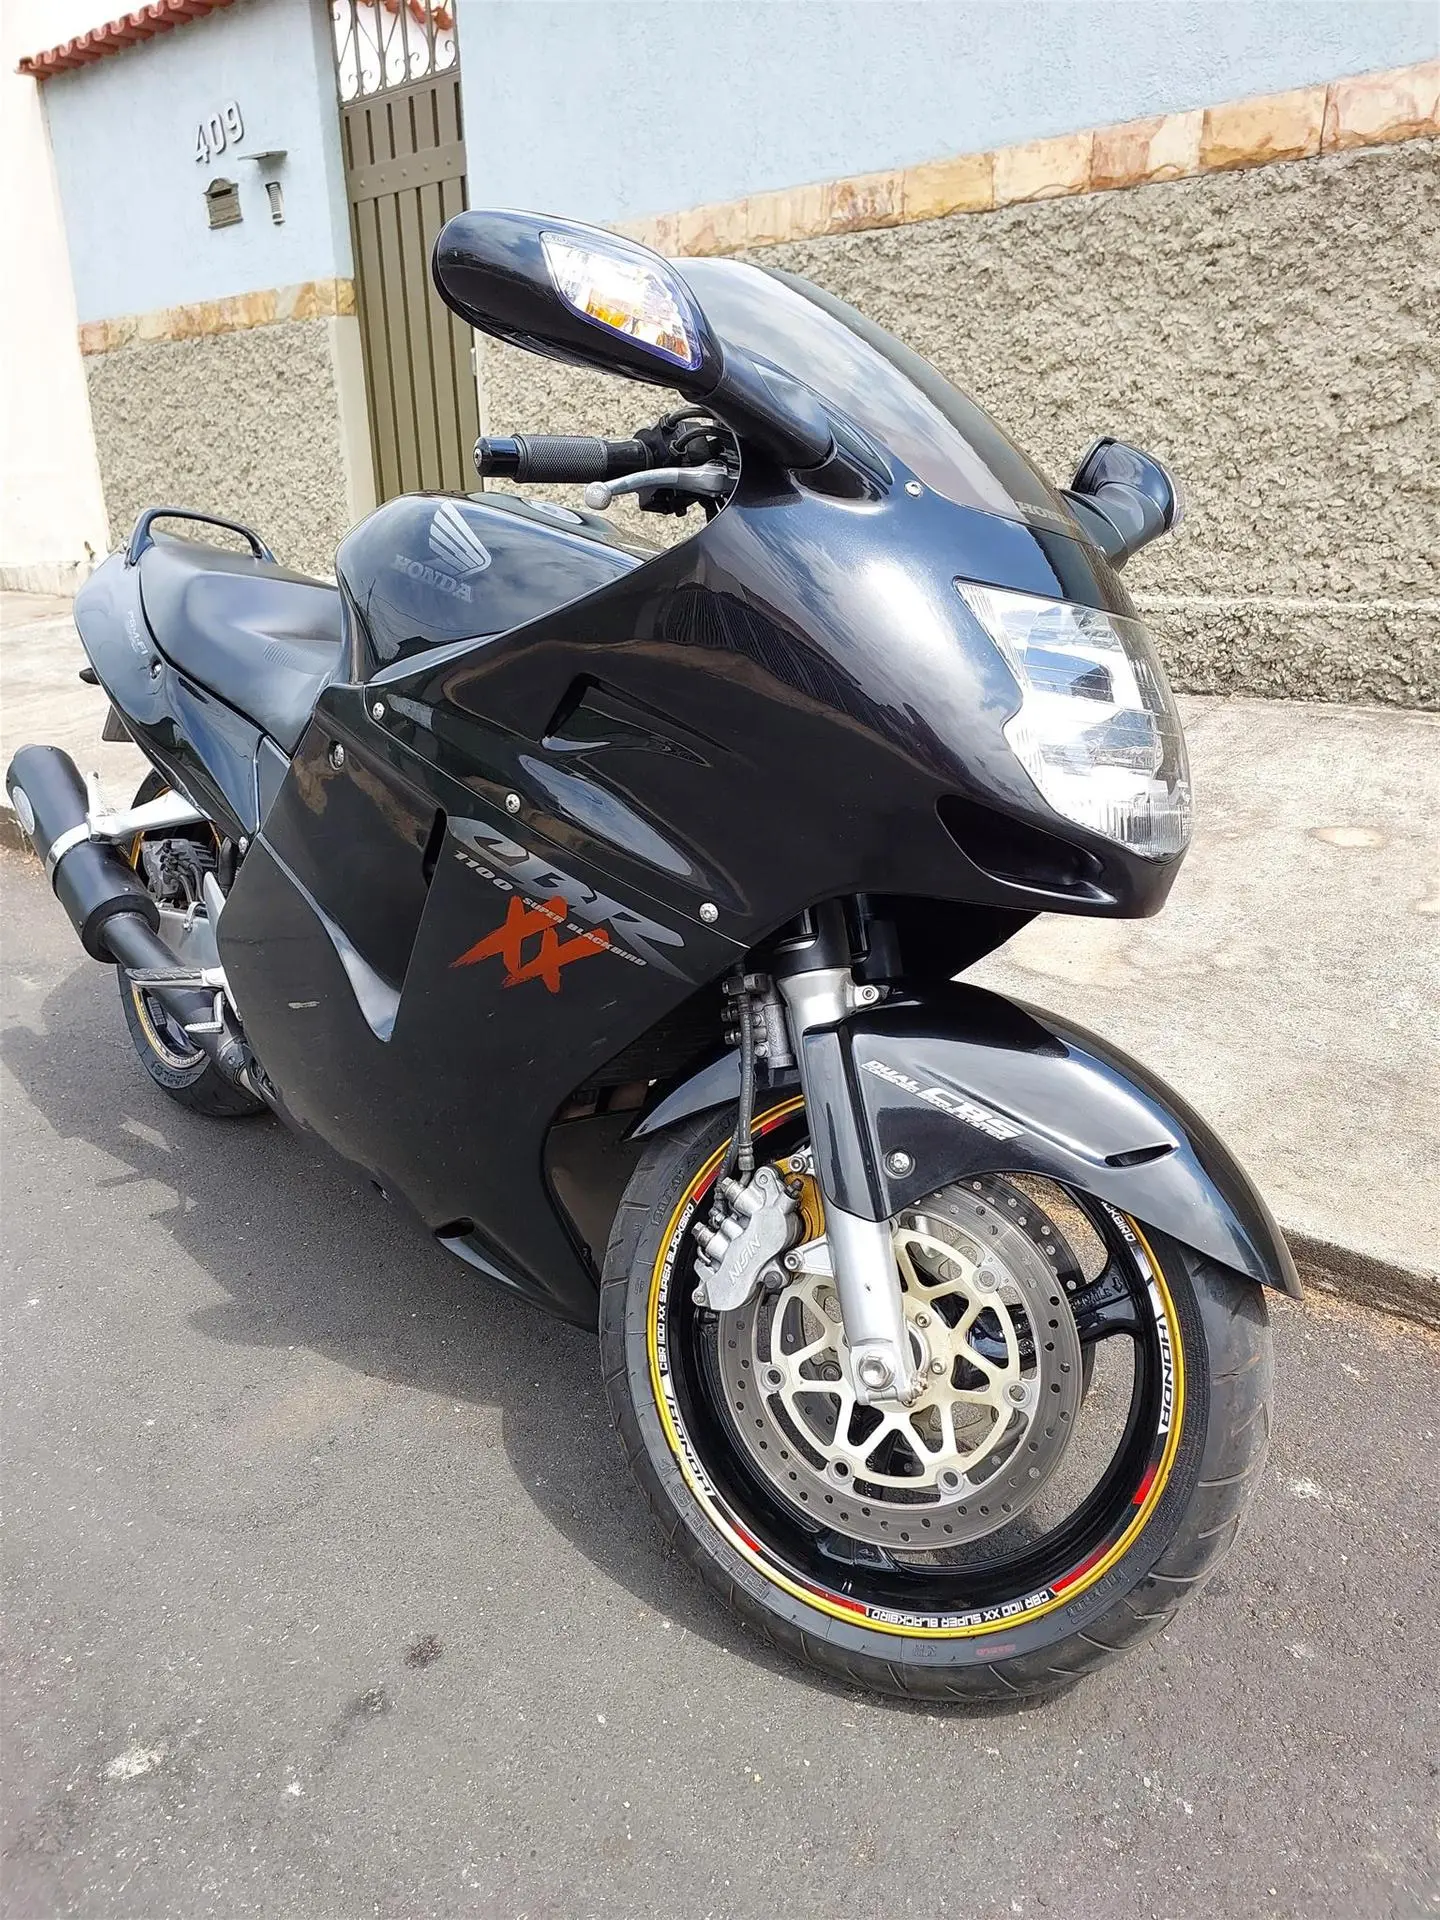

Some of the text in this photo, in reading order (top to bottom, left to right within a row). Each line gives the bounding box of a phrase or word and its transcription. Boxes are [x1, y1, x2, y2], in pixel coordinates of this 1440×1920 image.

[195, 99, 245, 164] 409
[390, 553, 473, 603] HONDA
[453, 850, 514, 892] 1100
[449, 895, 609, 993] XX
[522, 897, 648, 967] SUPER BLACKBIRD
[865, 1060, 1024, 1138] DUAL CBS
[665, 1202, 695, 1264] BLACKBIRD
[658, 1265, 672, 1302] SUPER
[657, 1302, 666, 1321] XX
[657, 1343, 668, 1371] CBR
[1158, 1324, 1172, 1428] HONDA
[668, 1403, 712, 1492] HONDA
[871, 1610, 937, 1628] BLACKBIRD
[941, 1613, 981, 1627] SUPER
[983, 1610, 1000, 1621] XX
[1025, 1591, 1049, 1608] CBR
